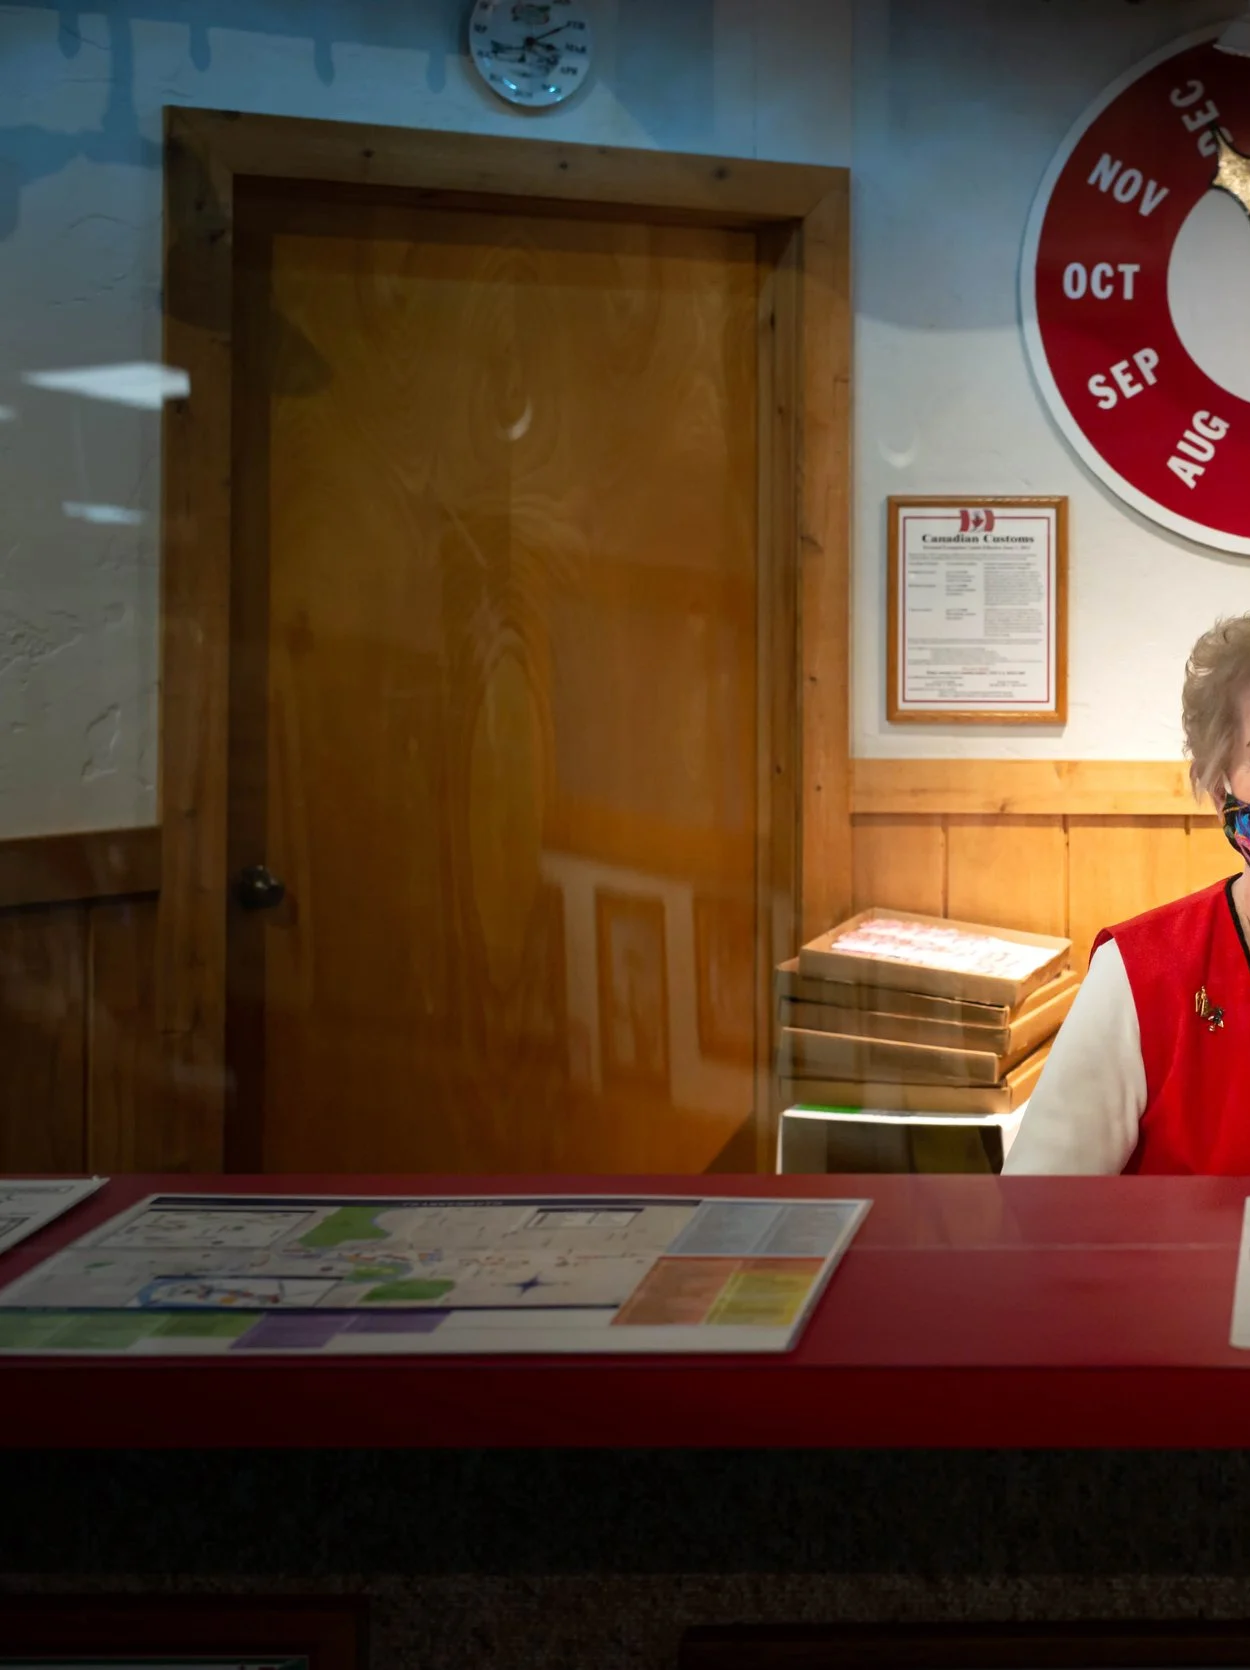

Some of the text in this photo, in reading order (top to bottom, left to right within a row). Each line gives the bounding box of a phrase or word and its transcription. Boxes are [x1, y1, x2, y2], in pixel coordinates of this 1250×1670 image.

[1087, 153, 1170, 217] NOV
[1062, 262, 1141, 300] OCT
[1087, 347, 1161, 410] SEP
[1166, 410, 1231, 489] AUG
[921, 533, 1035, 544] Canadian Customs
